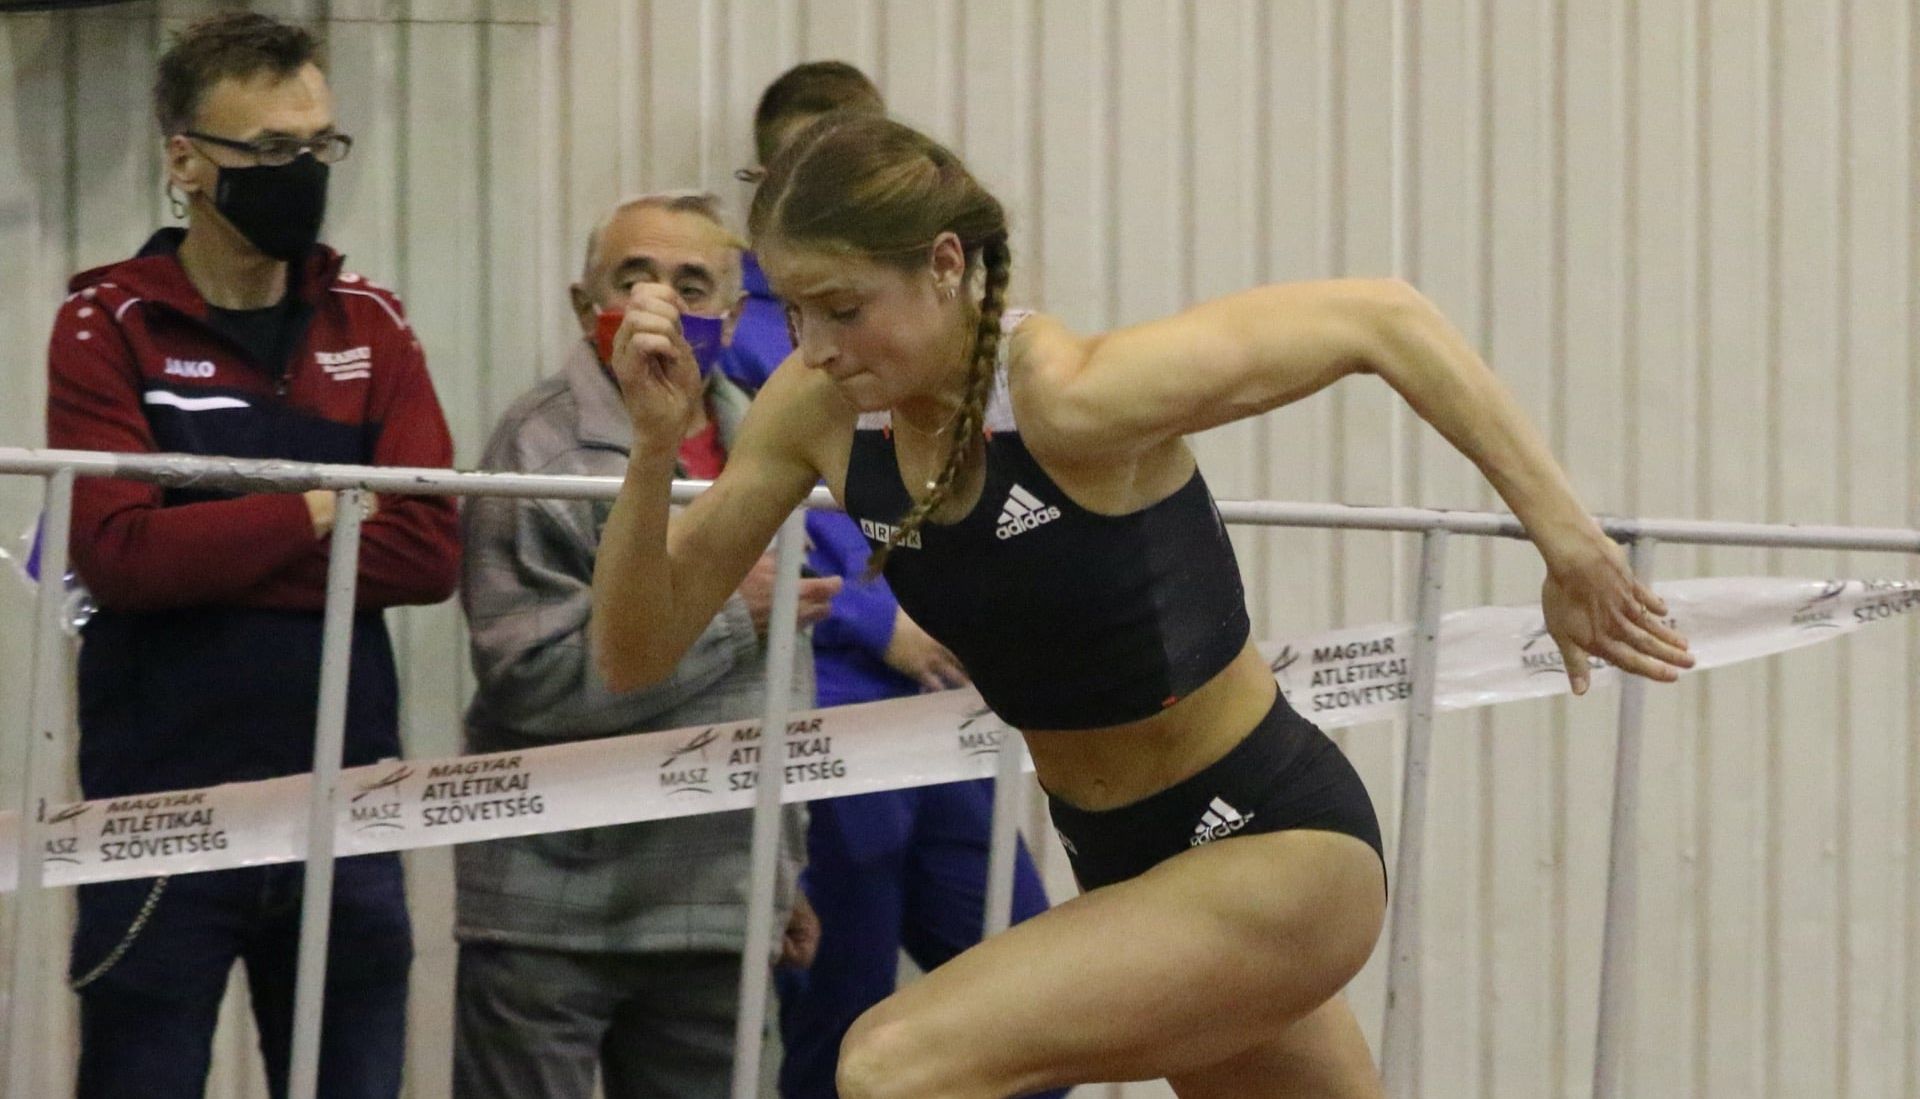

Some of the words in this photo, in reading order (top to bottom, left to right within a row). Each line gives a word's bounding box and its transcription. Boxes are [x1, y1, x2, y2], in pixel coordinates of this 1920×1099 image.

[861, 520, 921, 549] ARK
[996, 506, 1061, 541] adidas
[1311, 637, 1396, 664] MAGYAR
[1311, 657, 1408, 688] ATLÉTIKAI
[427, 755, 523, 780] MAGYAR
[659, 767, 709, 787] MASZ
[421, 772, 531, 801] ATLÉTIKAI
[105, 793, 207, 814] MAGYAR
[351, 802, 401, 822] MASZ
[423, 794, 546, 828] SZÖVETSÉG
[101, 830, 229, 863] SZÖVETSÉG
